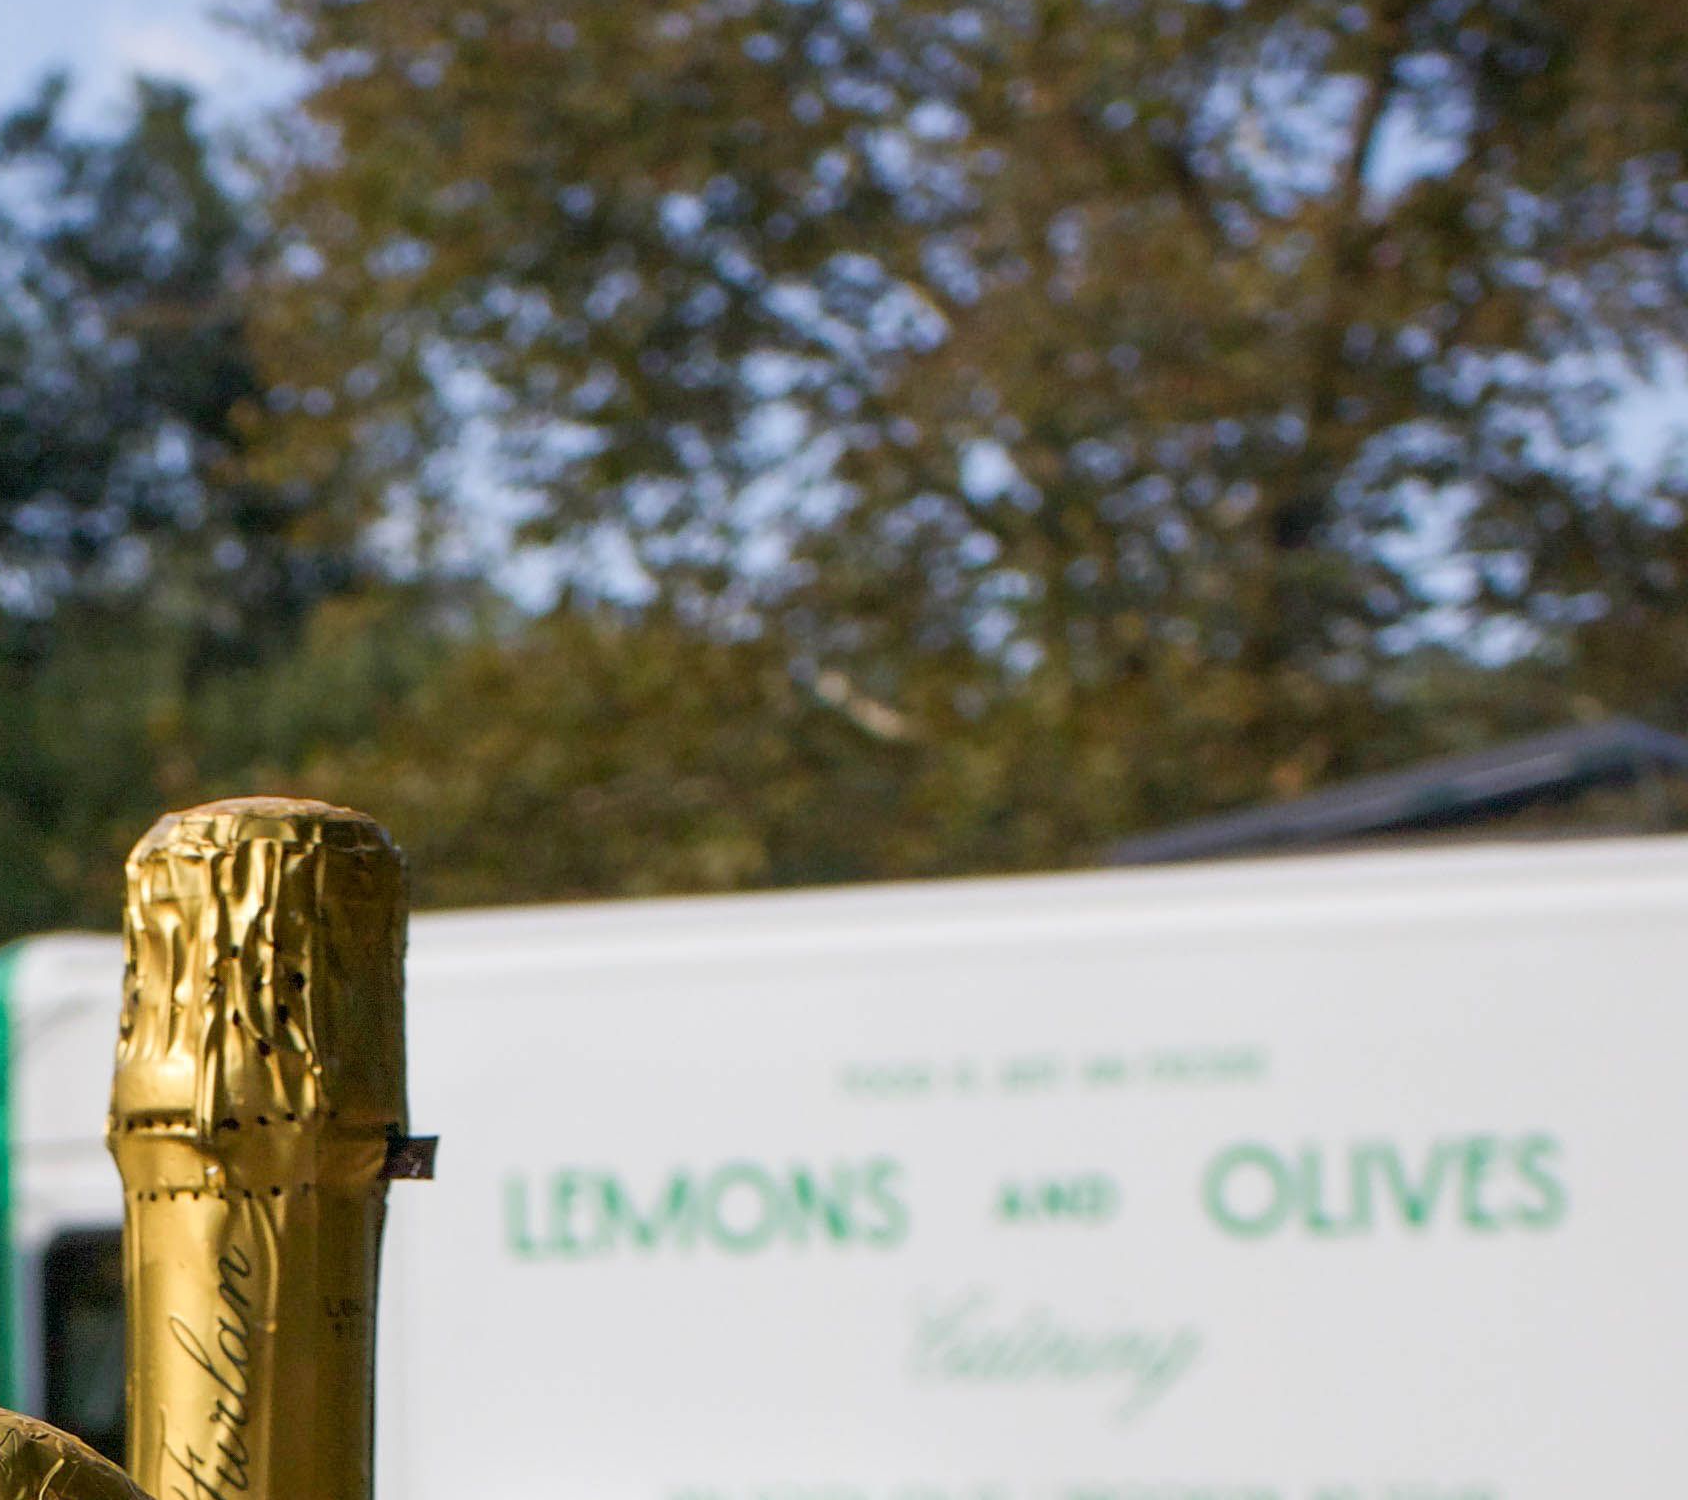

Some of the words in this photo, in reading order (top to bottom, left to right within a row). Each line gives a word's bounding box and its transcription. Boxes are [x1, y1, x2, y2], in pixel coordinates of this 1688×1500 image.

[505, 1153, 909, 1259] LEMONS
[995, 1170, 1120, 1224] AND
[1201, 1132, 1569, 1239] OLIVES
